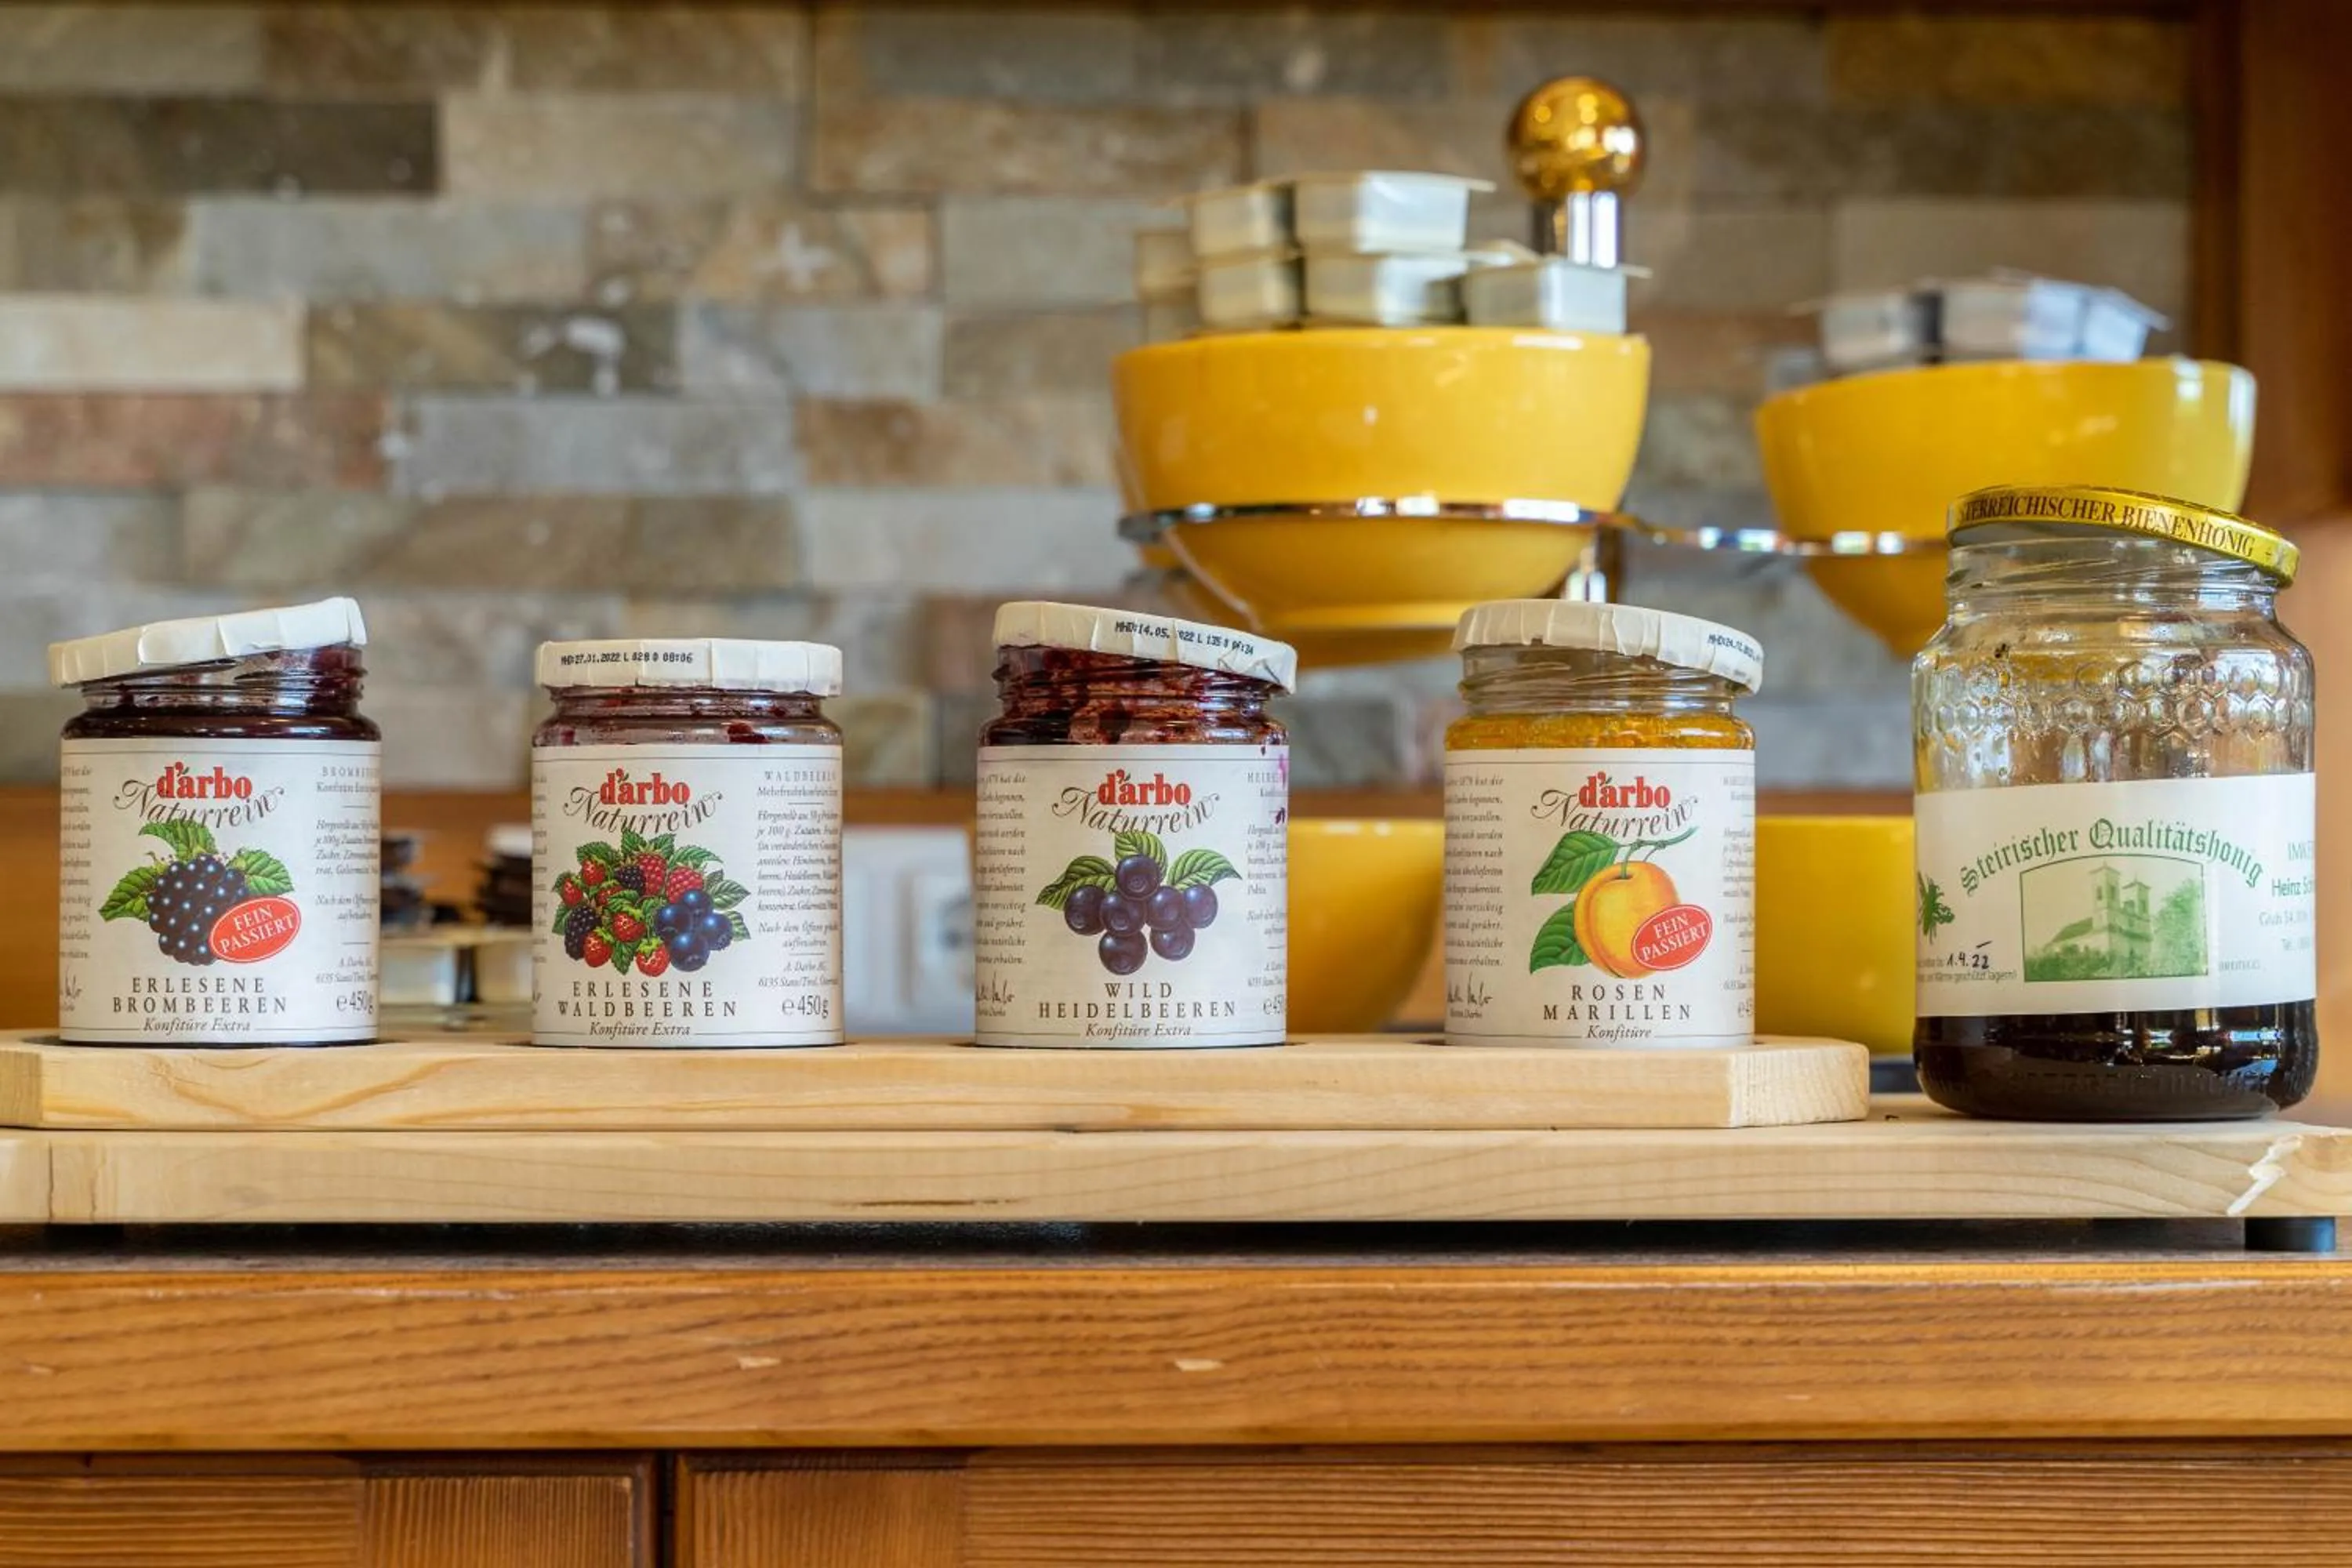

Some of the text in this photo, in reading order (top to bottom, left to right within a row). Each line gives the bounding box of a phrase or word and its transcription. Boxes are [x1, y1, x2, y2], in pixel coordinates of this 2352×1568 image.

[112, 779, 285, 829] Naturrein
[562, 786, 723, 834] Naturrein
[1051, 786, 1221, 835] Naturrein
[1530, 789, 1698, 838] Naturrein
[1960, 818, 2265, 898] Steirischer Qualitätshonig
[2271, 877, 2302, 898] Heinz
[234, 904, 274, 931] FEIN
[1653, 913, 1690, 938] FEIN
[220, 913, 295, 954] PASSIERT
[1641, 920, 1707, 961] PASSIERT
[132, 977, 265, 993] ERLESENE
[572, 981, 713, 998] ERLESENE
[1104, 982, 1173, 998] WILD
[1571, 984, 1666, 1001] ROSEN
[112, 996, 287, 1014] BROMBEEREN
[557, 1000, 737, 1018] WALDBEEREN
[1038, 1001, 1236, 1018] HEIDELBEEREN
[1543, 1004, 1692, 1020] MARILLEN
[143, 1017, 251, 1036] Konfitüre Extra
[589, 1021, 691, 1040] Konfitüre Extra
[1085, 1022, 1192, 1040] Konfitüre Extra
[1587, 1024, 1652, 1043] Konfitüre
